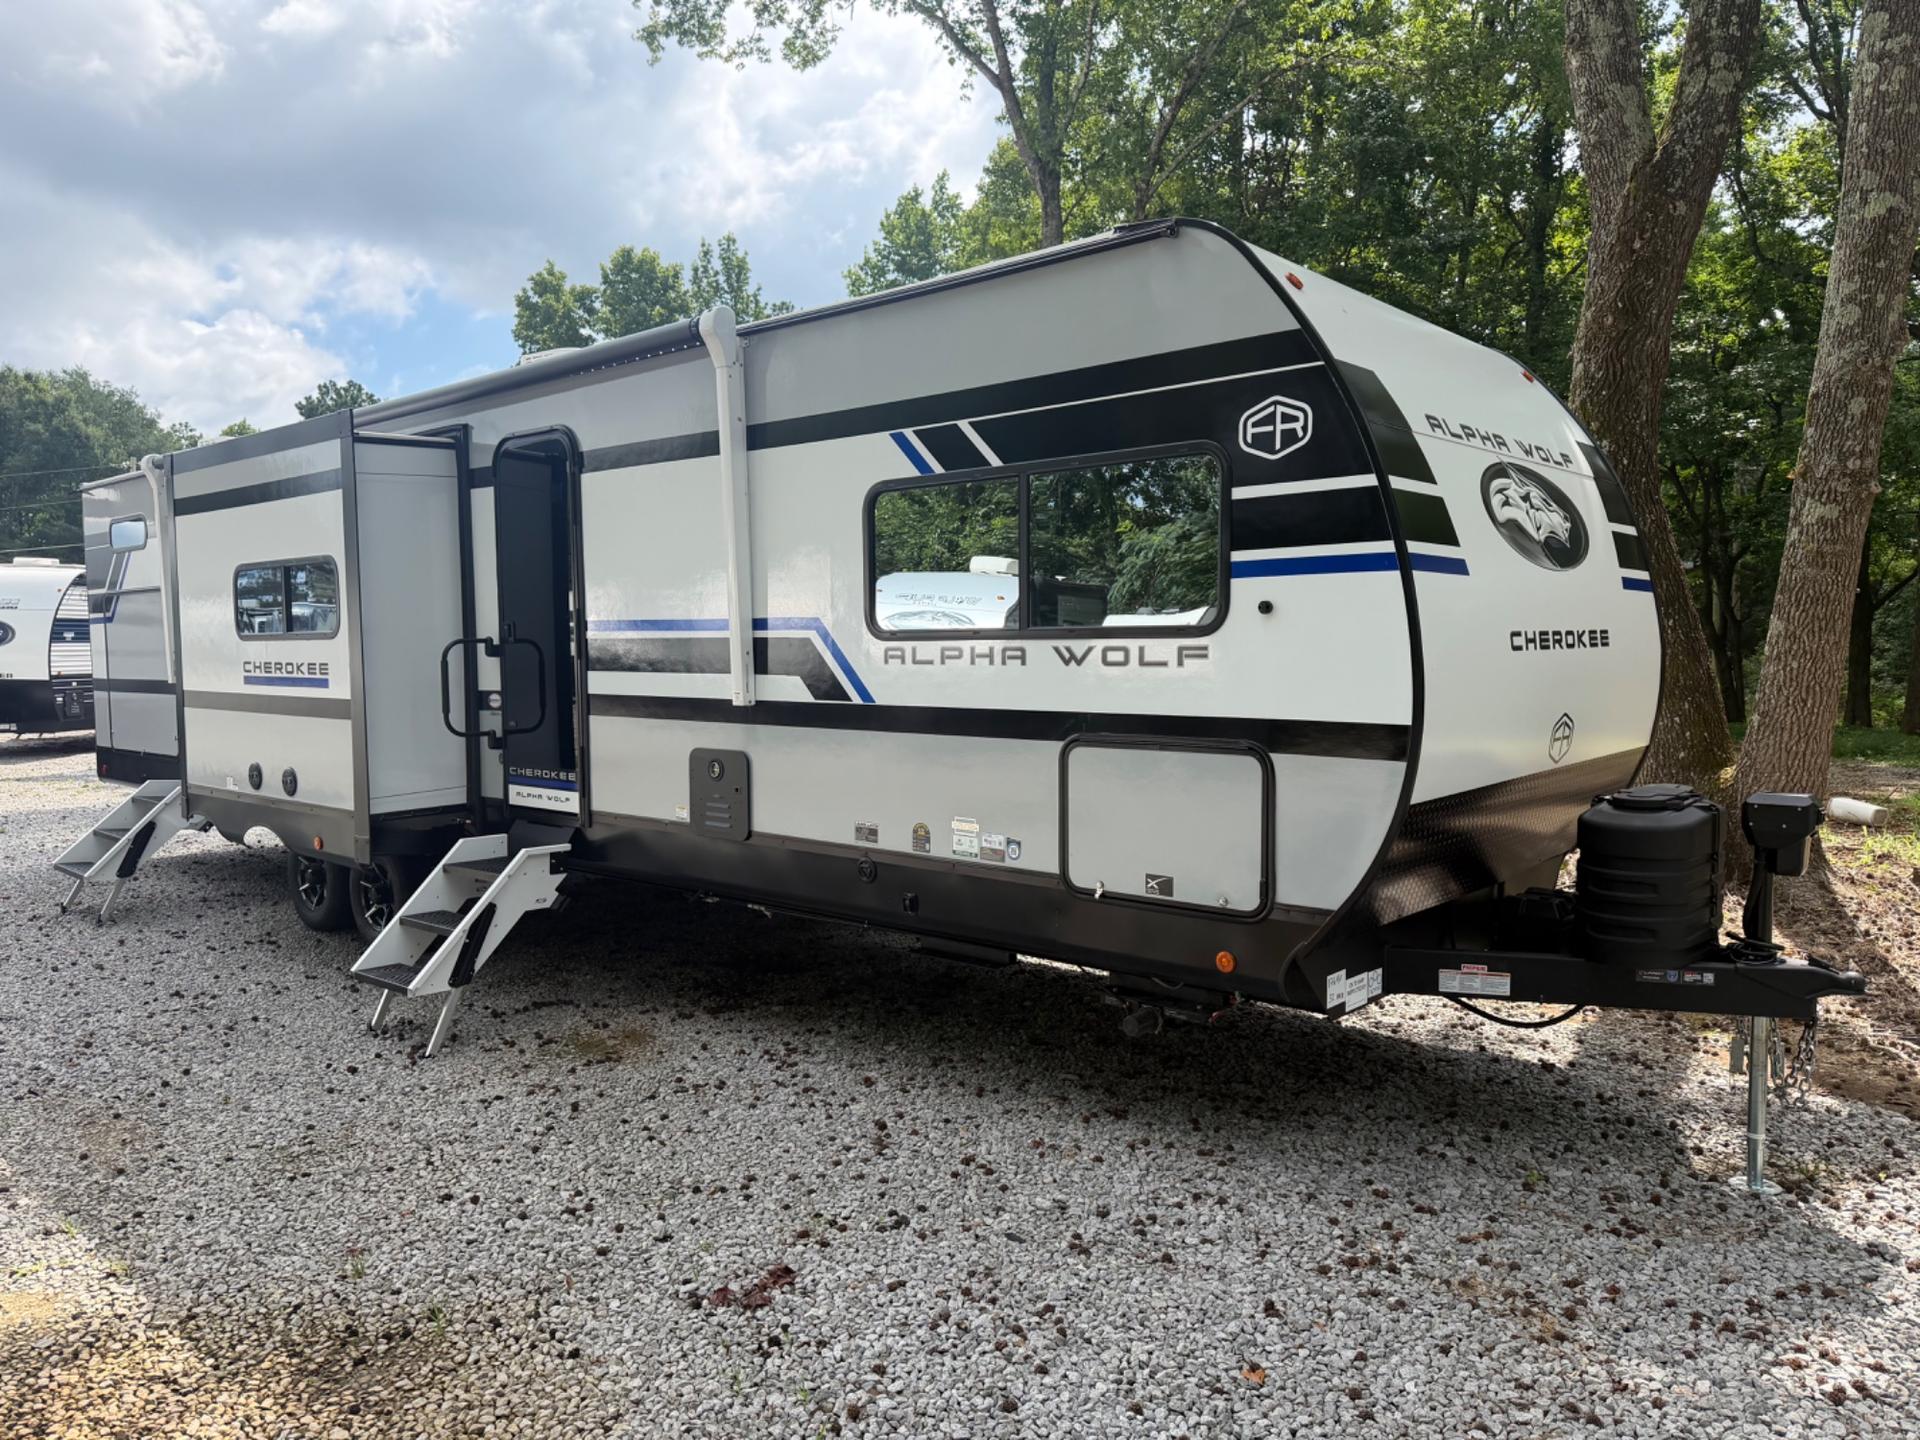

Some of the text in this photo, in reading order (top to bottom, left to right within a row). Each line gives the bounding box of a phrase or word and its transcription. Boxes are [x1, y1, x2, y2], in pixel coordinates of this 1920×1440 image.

[1425, 413, 1574, 469] ALPHA WOLF
[1510, 628, 1610, 652] CHEROKEE
[883, 645, 1209, 667] ALPHA WOLF
[243, 661, 329, 675] CHEROKEE
[509, 767, 576, 781] CHEROKEE
[515, 791, 571, 804] ALPHA WOLF
